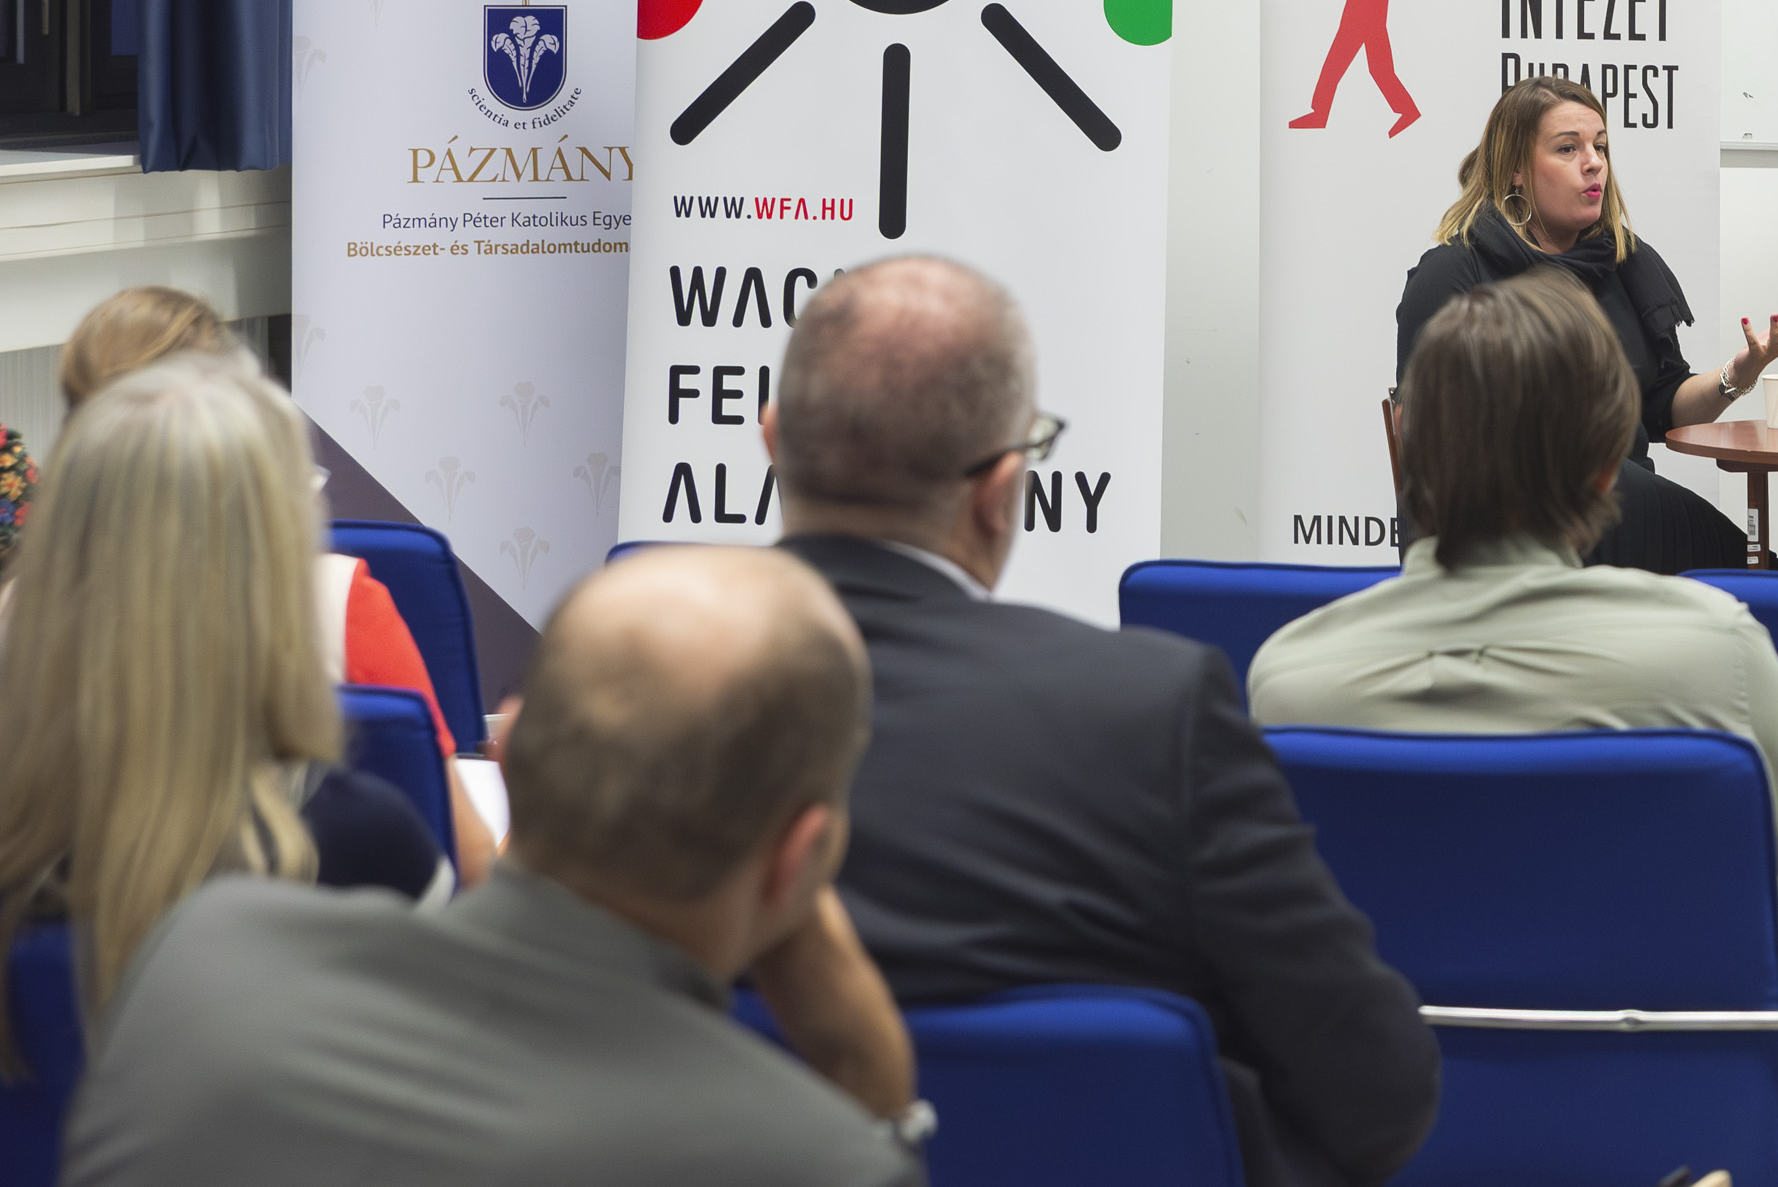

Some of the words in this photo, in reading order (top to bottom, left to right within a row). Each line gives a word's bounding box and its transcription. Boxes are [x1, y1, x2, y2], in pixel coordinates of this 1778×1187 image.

[467, 86, 510, 128] scientia
[513, 118, 528, 131] et
[531, 85, 583, 130] fidelitate
[382, 212, 458, 232] Pázmány
[462, 210, 506, 229] Péter
[510, 210, 588, 228] Katolikus
[592, 211, 632, 231] Egye
[673, 194, 854, 222] WWW.WFA.HU
[347, 238, 446, 257] Bölcsészet-
[450, 238, 470, 256] és
[474, 237, 630, 257] Társadalomtudom
[669, 264, 846, 329] WAC
[1293, 514, 1400, 547] MINDE
